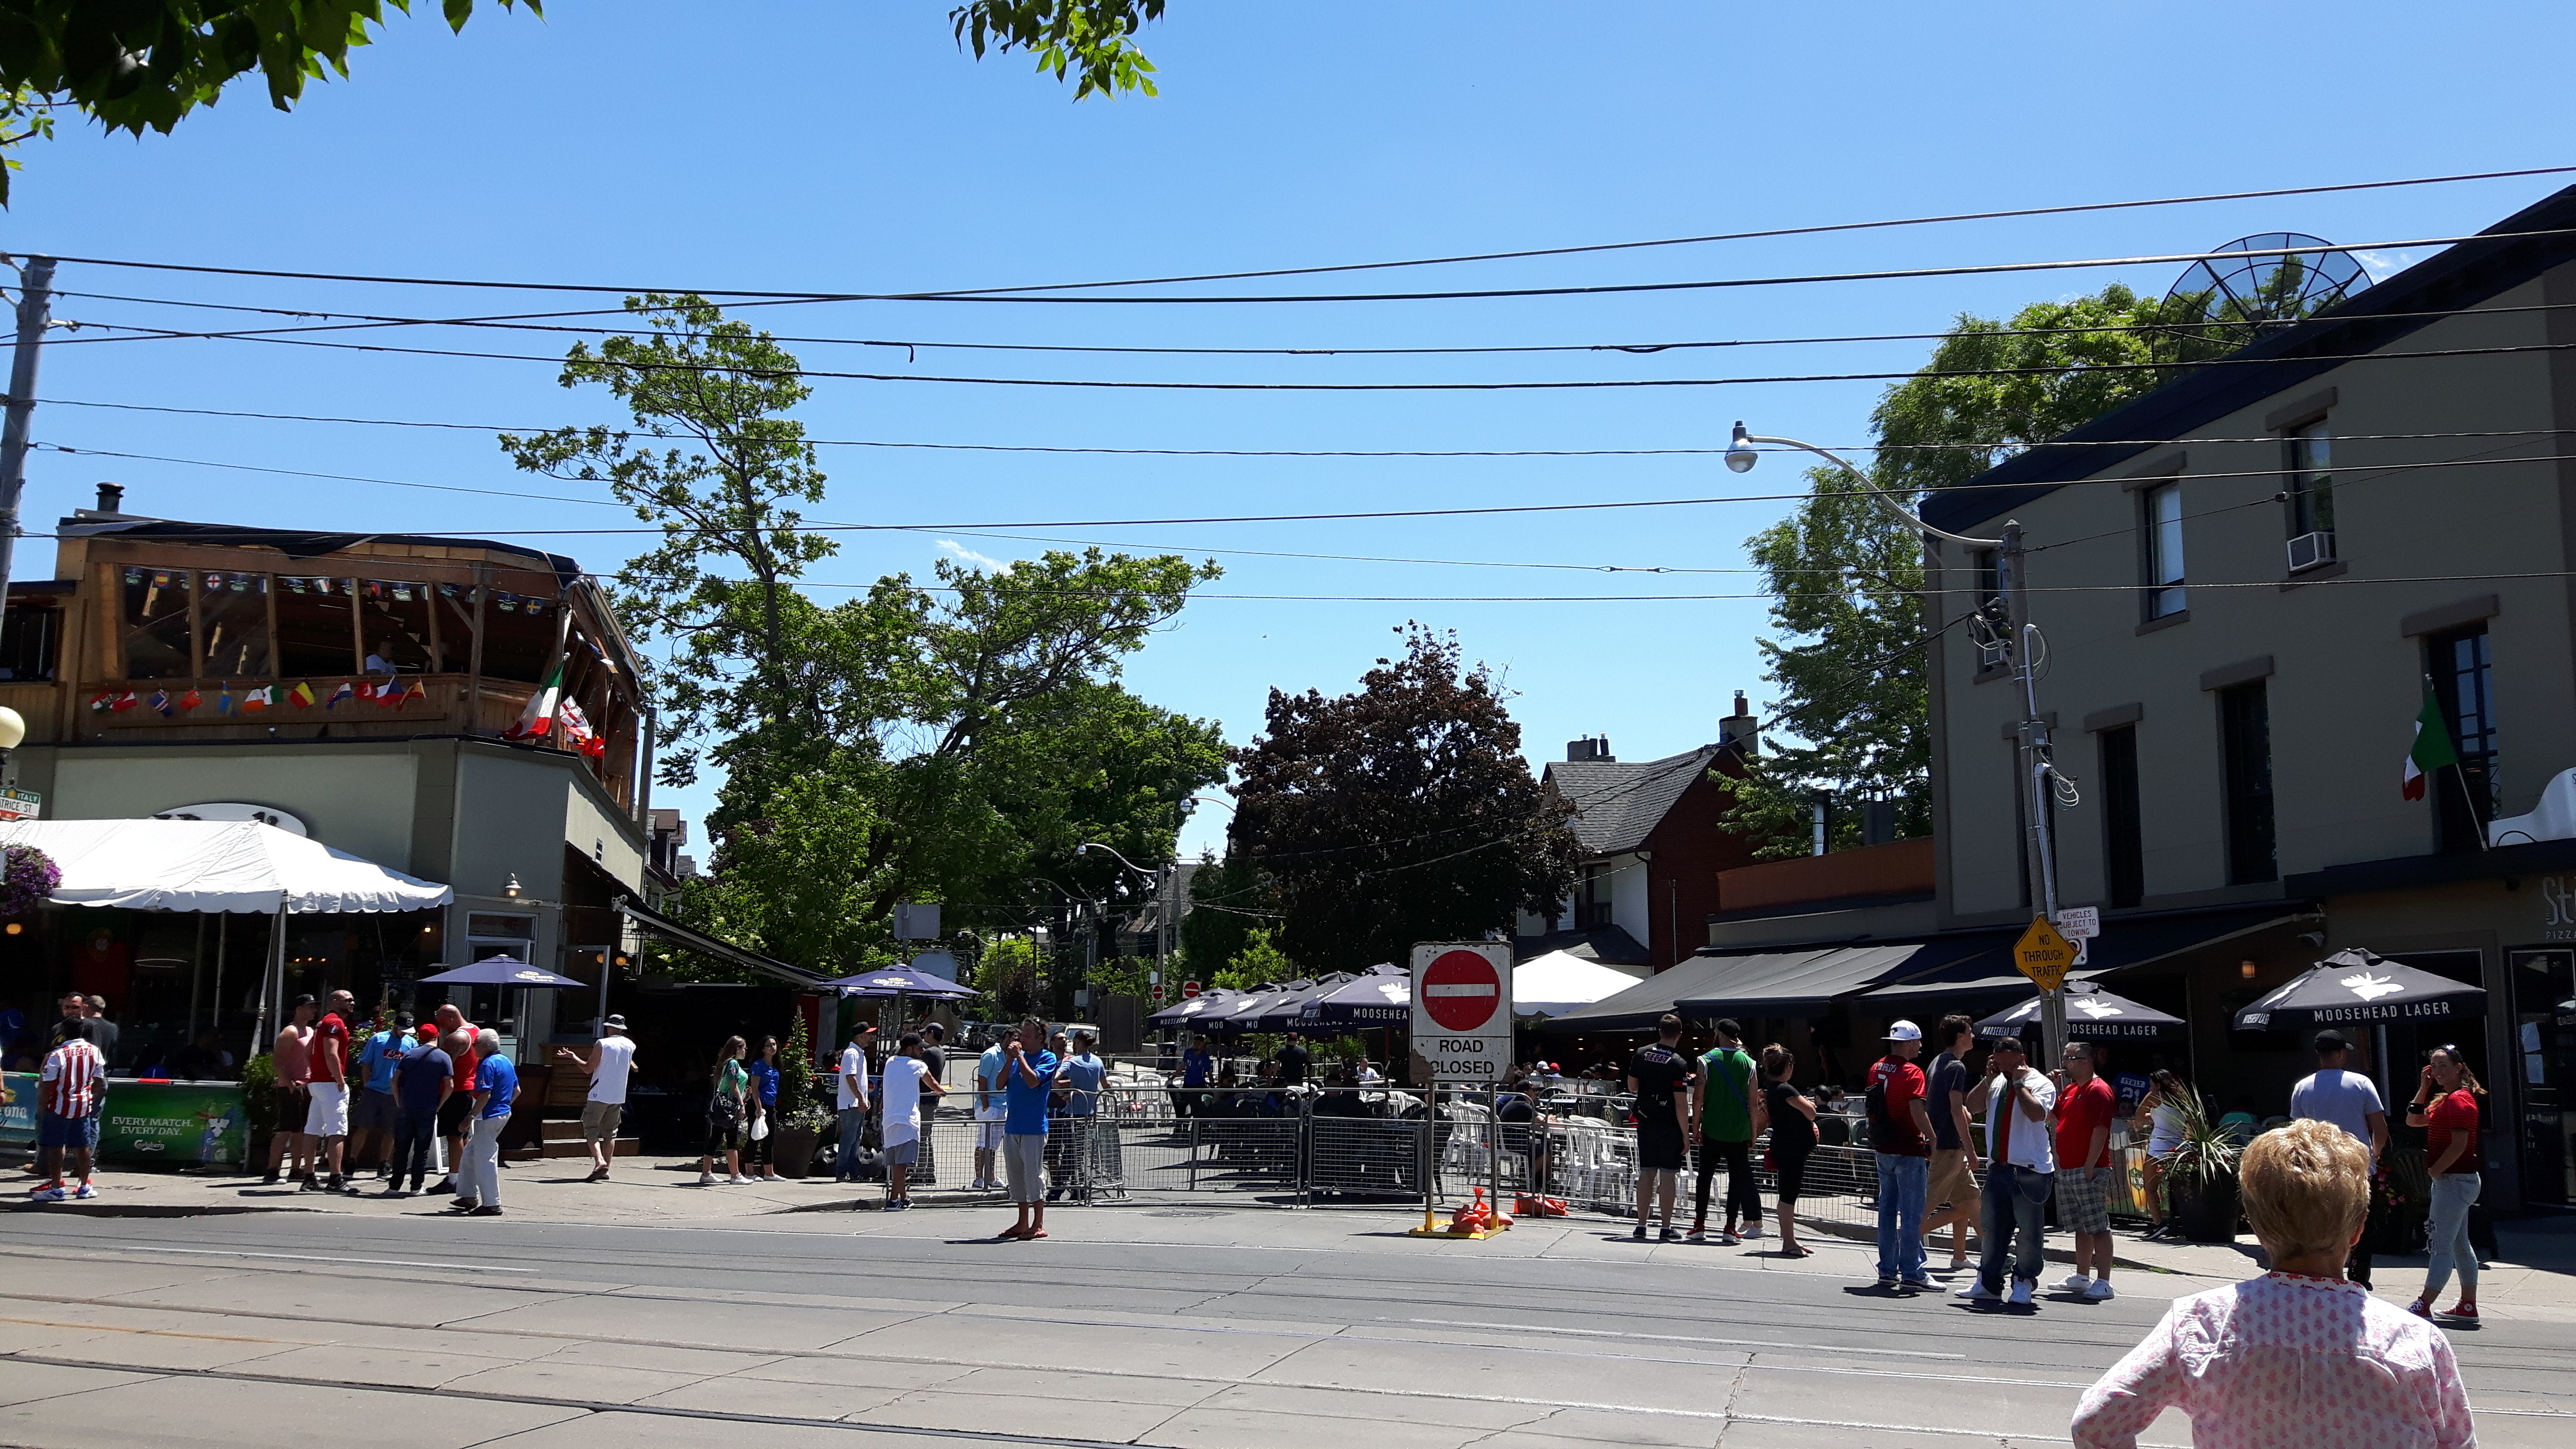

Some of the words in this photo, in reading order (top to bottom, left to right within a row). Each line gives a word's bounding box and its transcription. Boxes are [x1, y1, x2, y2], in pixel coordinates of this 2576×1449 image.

[17, 793, 38, 802] ITALY
[23, 804, 32, 813] ST
[2063, 910, 2091, 920] VEHICLES
[2059, 920, 2086, 929] SUBJECT
[2038, 934, 2050, 945] NO
[2023, 949, 2064, 962] THROUGH
[2032, 965, 2062, 977] TRAFFIC
[1353, 1008, 1408, 1020] MOOSEHEA
[2314, 1006, 2398, 1022] MOOSEHEAD
[2405, 1002, 2450, 1016] LAGER
[2067, 1024, 2118, 1035] OOSEHEAD
[2124, 1025, 2157, 1035] LAGER
[1439, 1040, 1483, 1053] ROAD
[1430, 1060, 1494, 1074] CLOSED
[112, 1116, 147, 1125] EVERY
[149, 1118, 193, 1127] MATCH.
[121, 1126, 157, 1135] EVERY
[158, 1127, 182, 1135] DAY.
